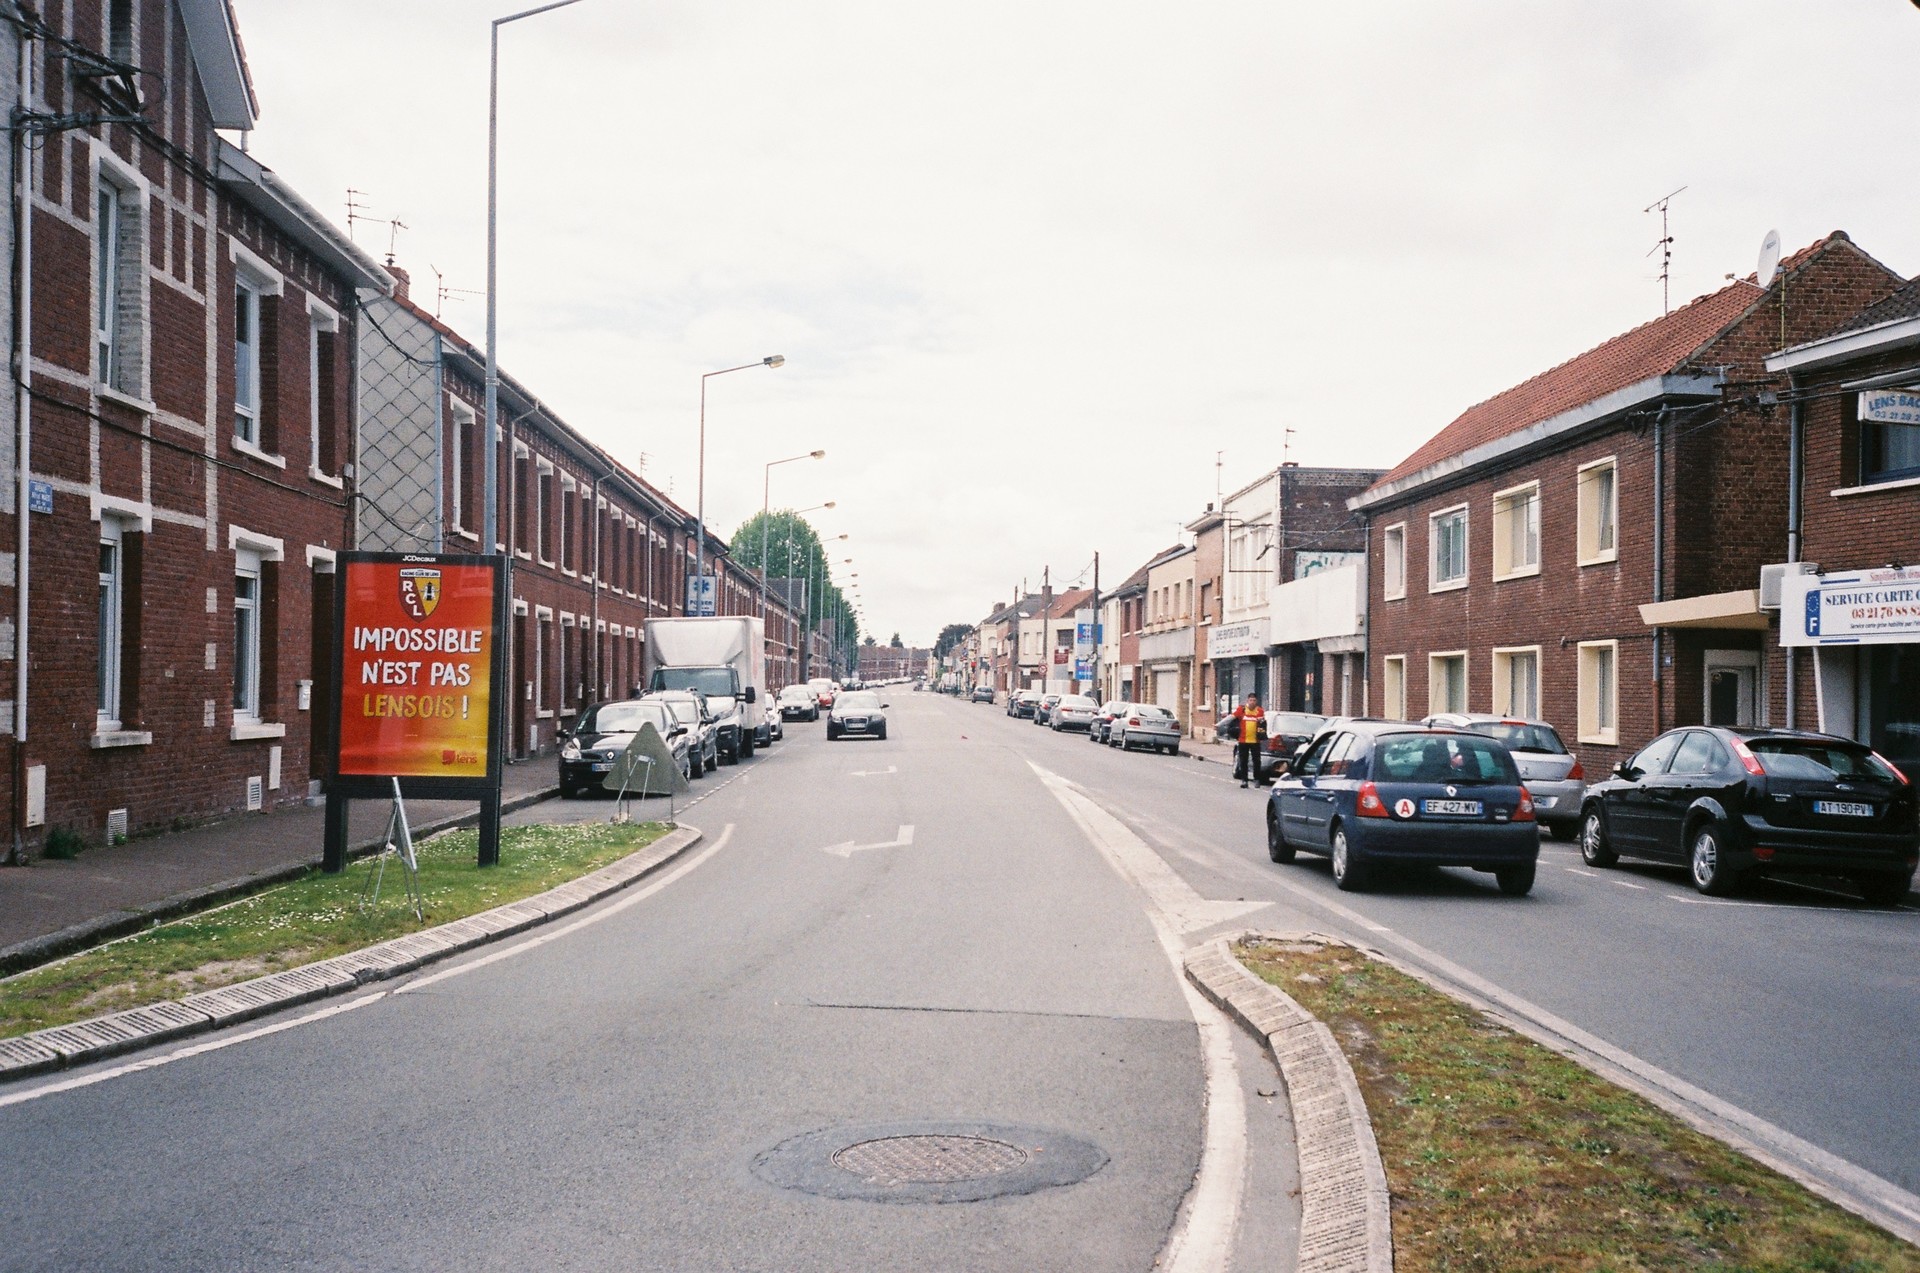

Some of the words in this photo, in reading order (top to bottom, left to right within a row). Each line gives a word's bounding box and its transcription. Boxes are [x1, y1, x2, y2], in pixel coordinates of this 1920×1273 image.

[1868, 395, 1896, 411] LENS
[1826, 592, 1873, 606] SERVICE
[1875, 590, 1913, 603] CARTE
[1852, 608, 1864, 619] 03
[1867, 608, 1878, 619] 21
[1881, 607, 1893, 619] 76
[1895, 606, 1908, 617] 88
[1809, 617, 1818, 632] F
[353, 627, 482, 653] IMPOSSIBLE
[362, 659, 422, 686] N'EST
[430, 662, 471, 687] PAS
[363, 694, 455, 719] LENSOIS
[1401, 801, 1410, 814] A
